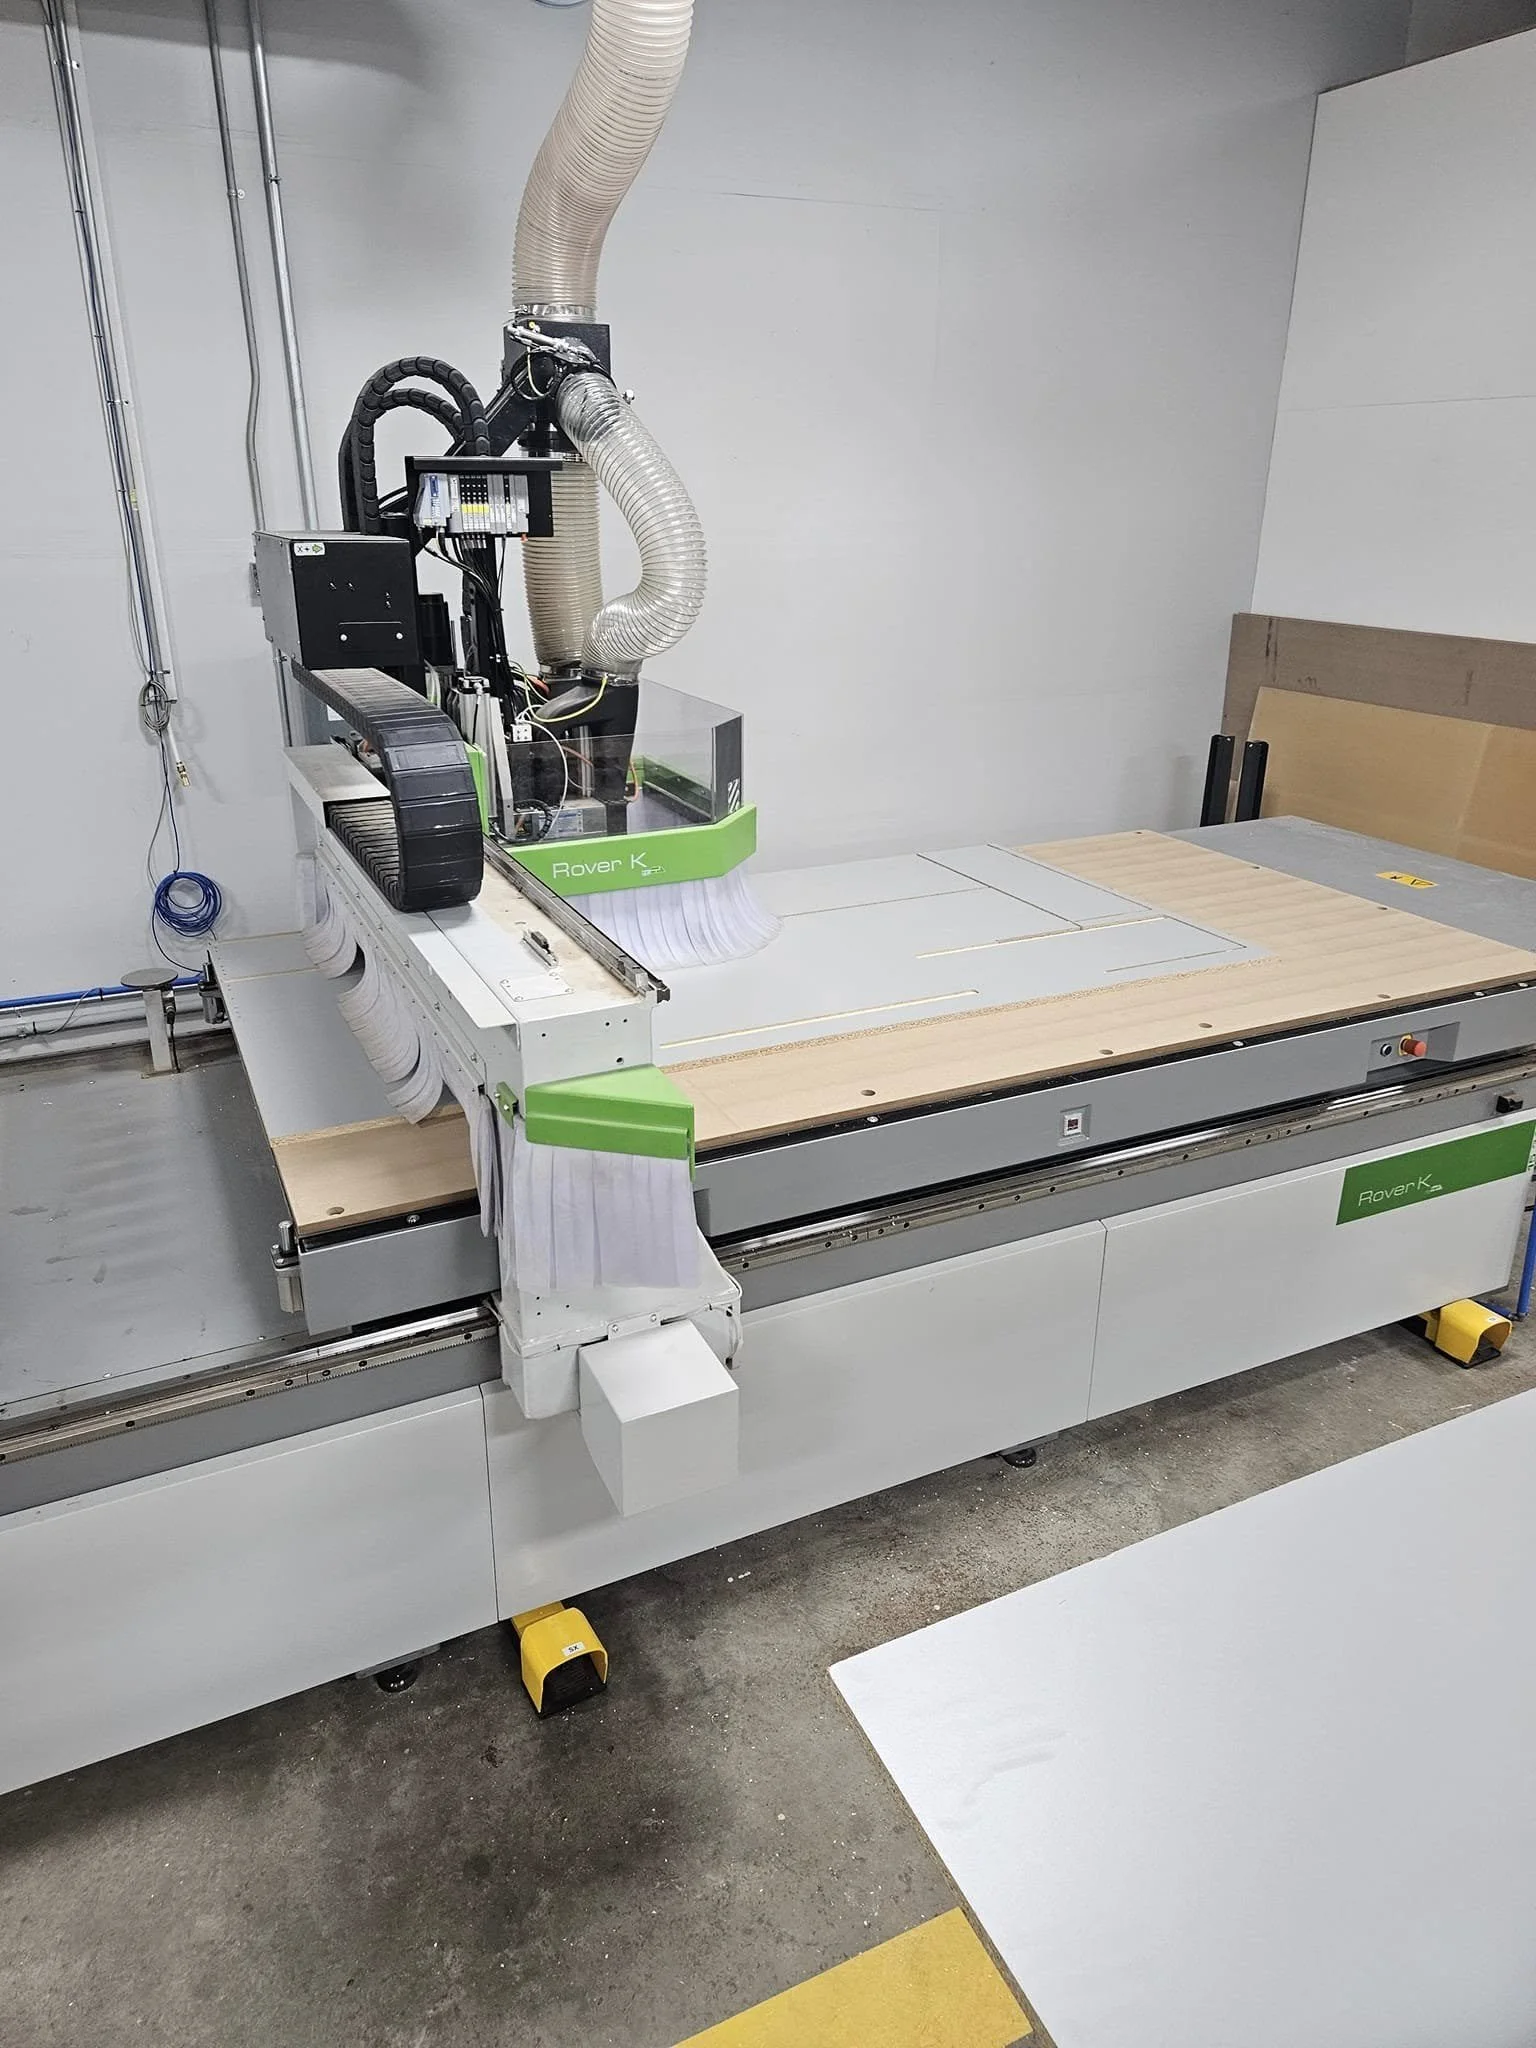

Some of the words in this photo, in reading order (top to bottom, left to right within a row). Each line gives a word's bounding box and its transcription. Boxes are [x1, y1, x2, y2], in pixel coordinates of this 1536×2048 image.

[552, 859, 623, 879] Rover
[630, 851, 648, 870] K
[1358, 1182, 1416, 1207] Rover
[1417, 1173, 1433, 1190] K
